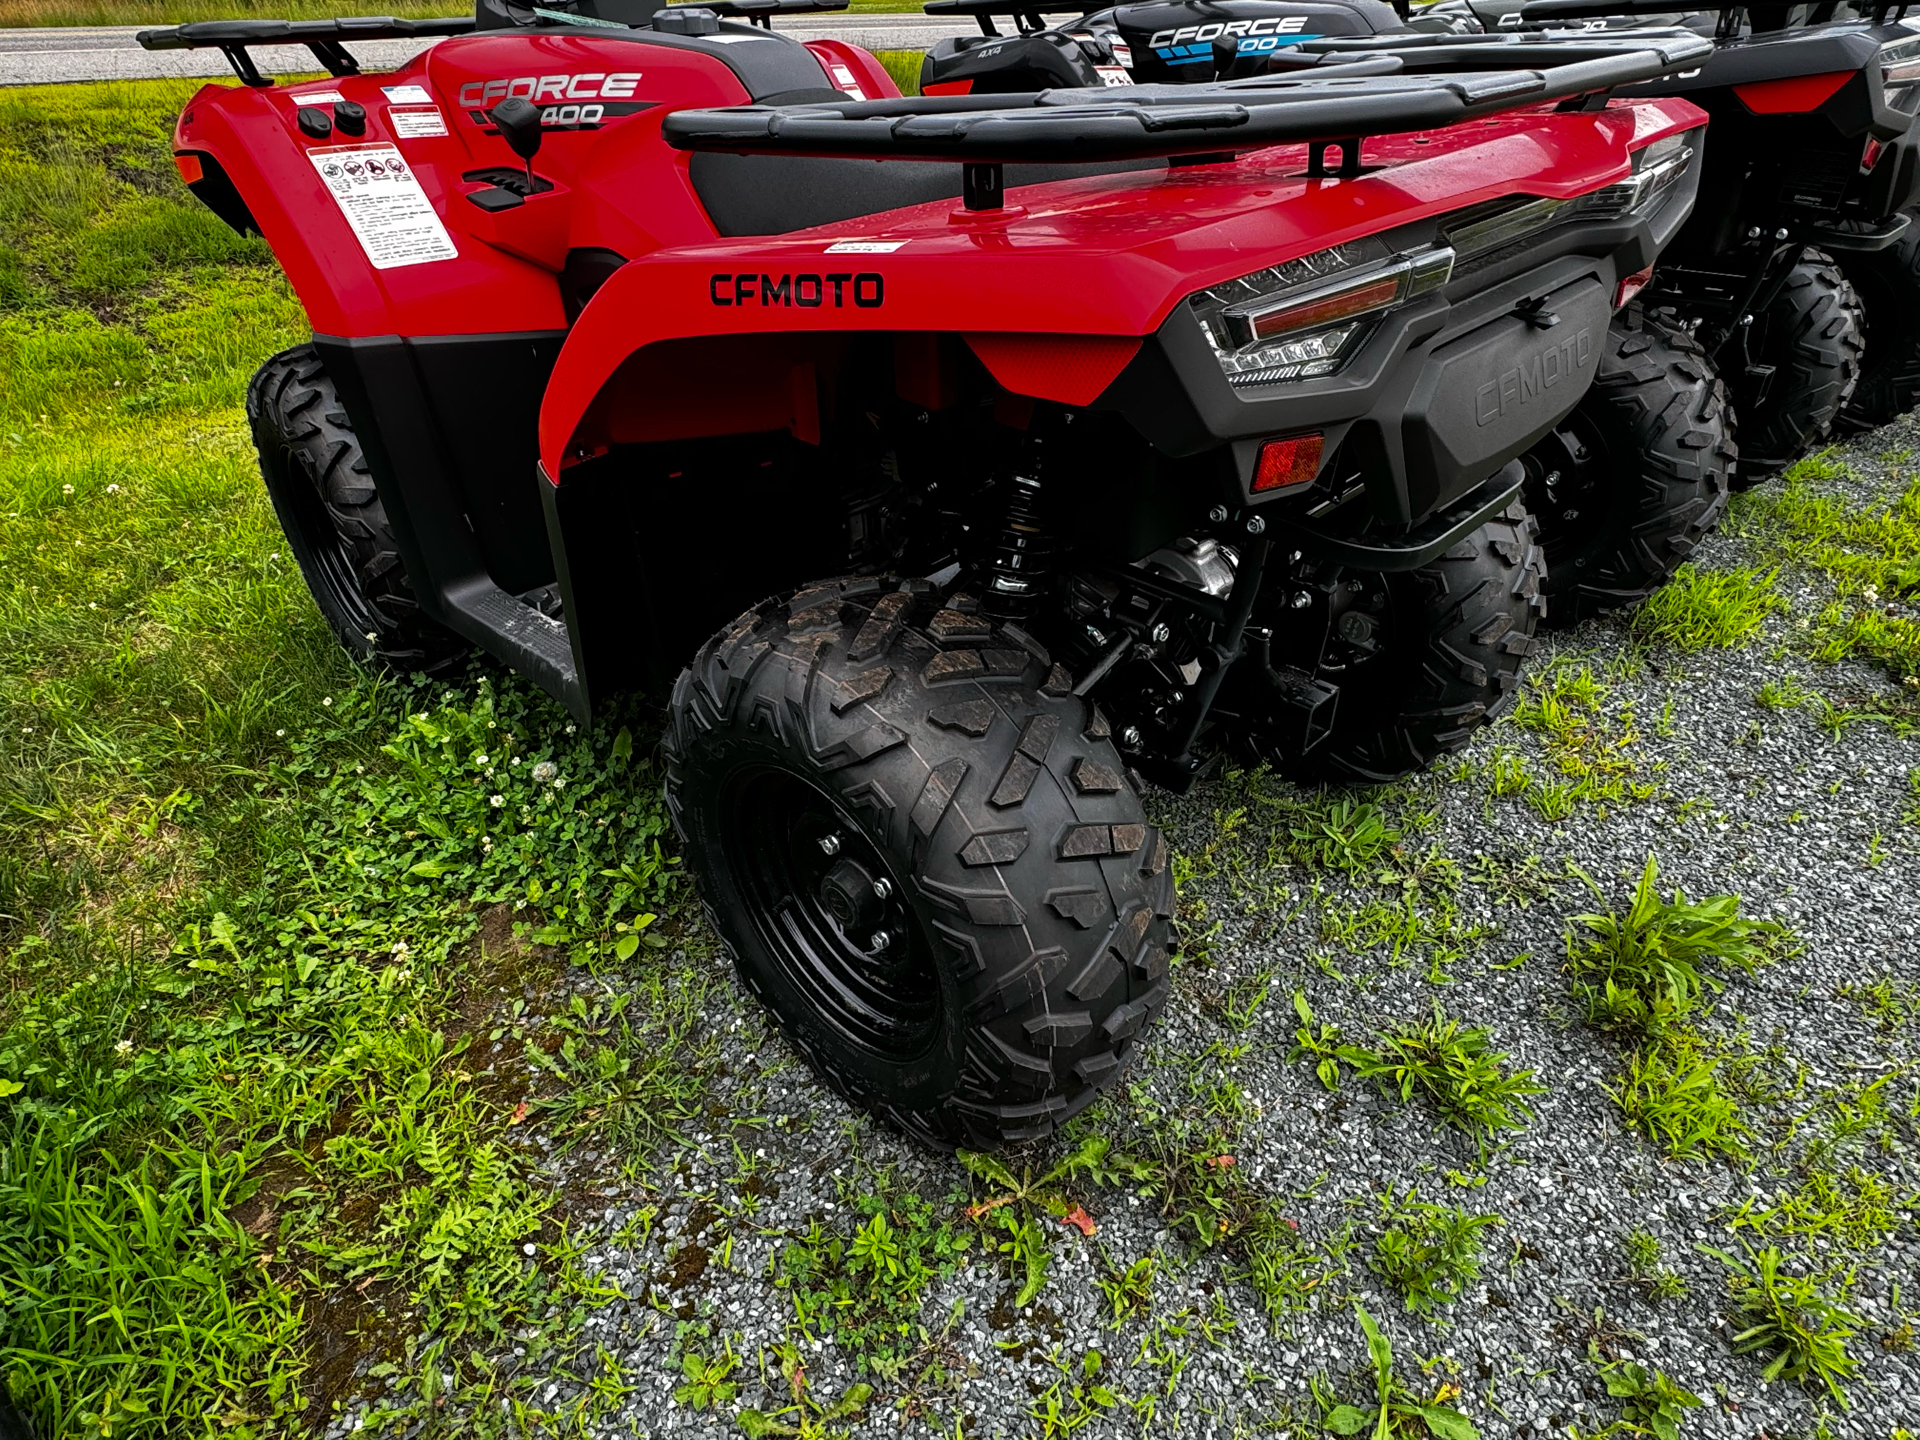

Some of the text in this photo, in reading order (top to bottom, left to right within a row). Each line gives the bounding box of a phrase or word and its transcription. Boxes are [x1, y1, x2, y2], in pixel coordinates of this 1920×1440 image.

[1149, 16, 1309, 48] CFORCE
[1237, 37, 1278, 52] 00
[458, 73, 643, 107] CFORCE
[540, 104, 604, 125] 400
[709, 272, 884, 308] CFMOTO
[1475, 327, 1589, 428] CFMOTO
